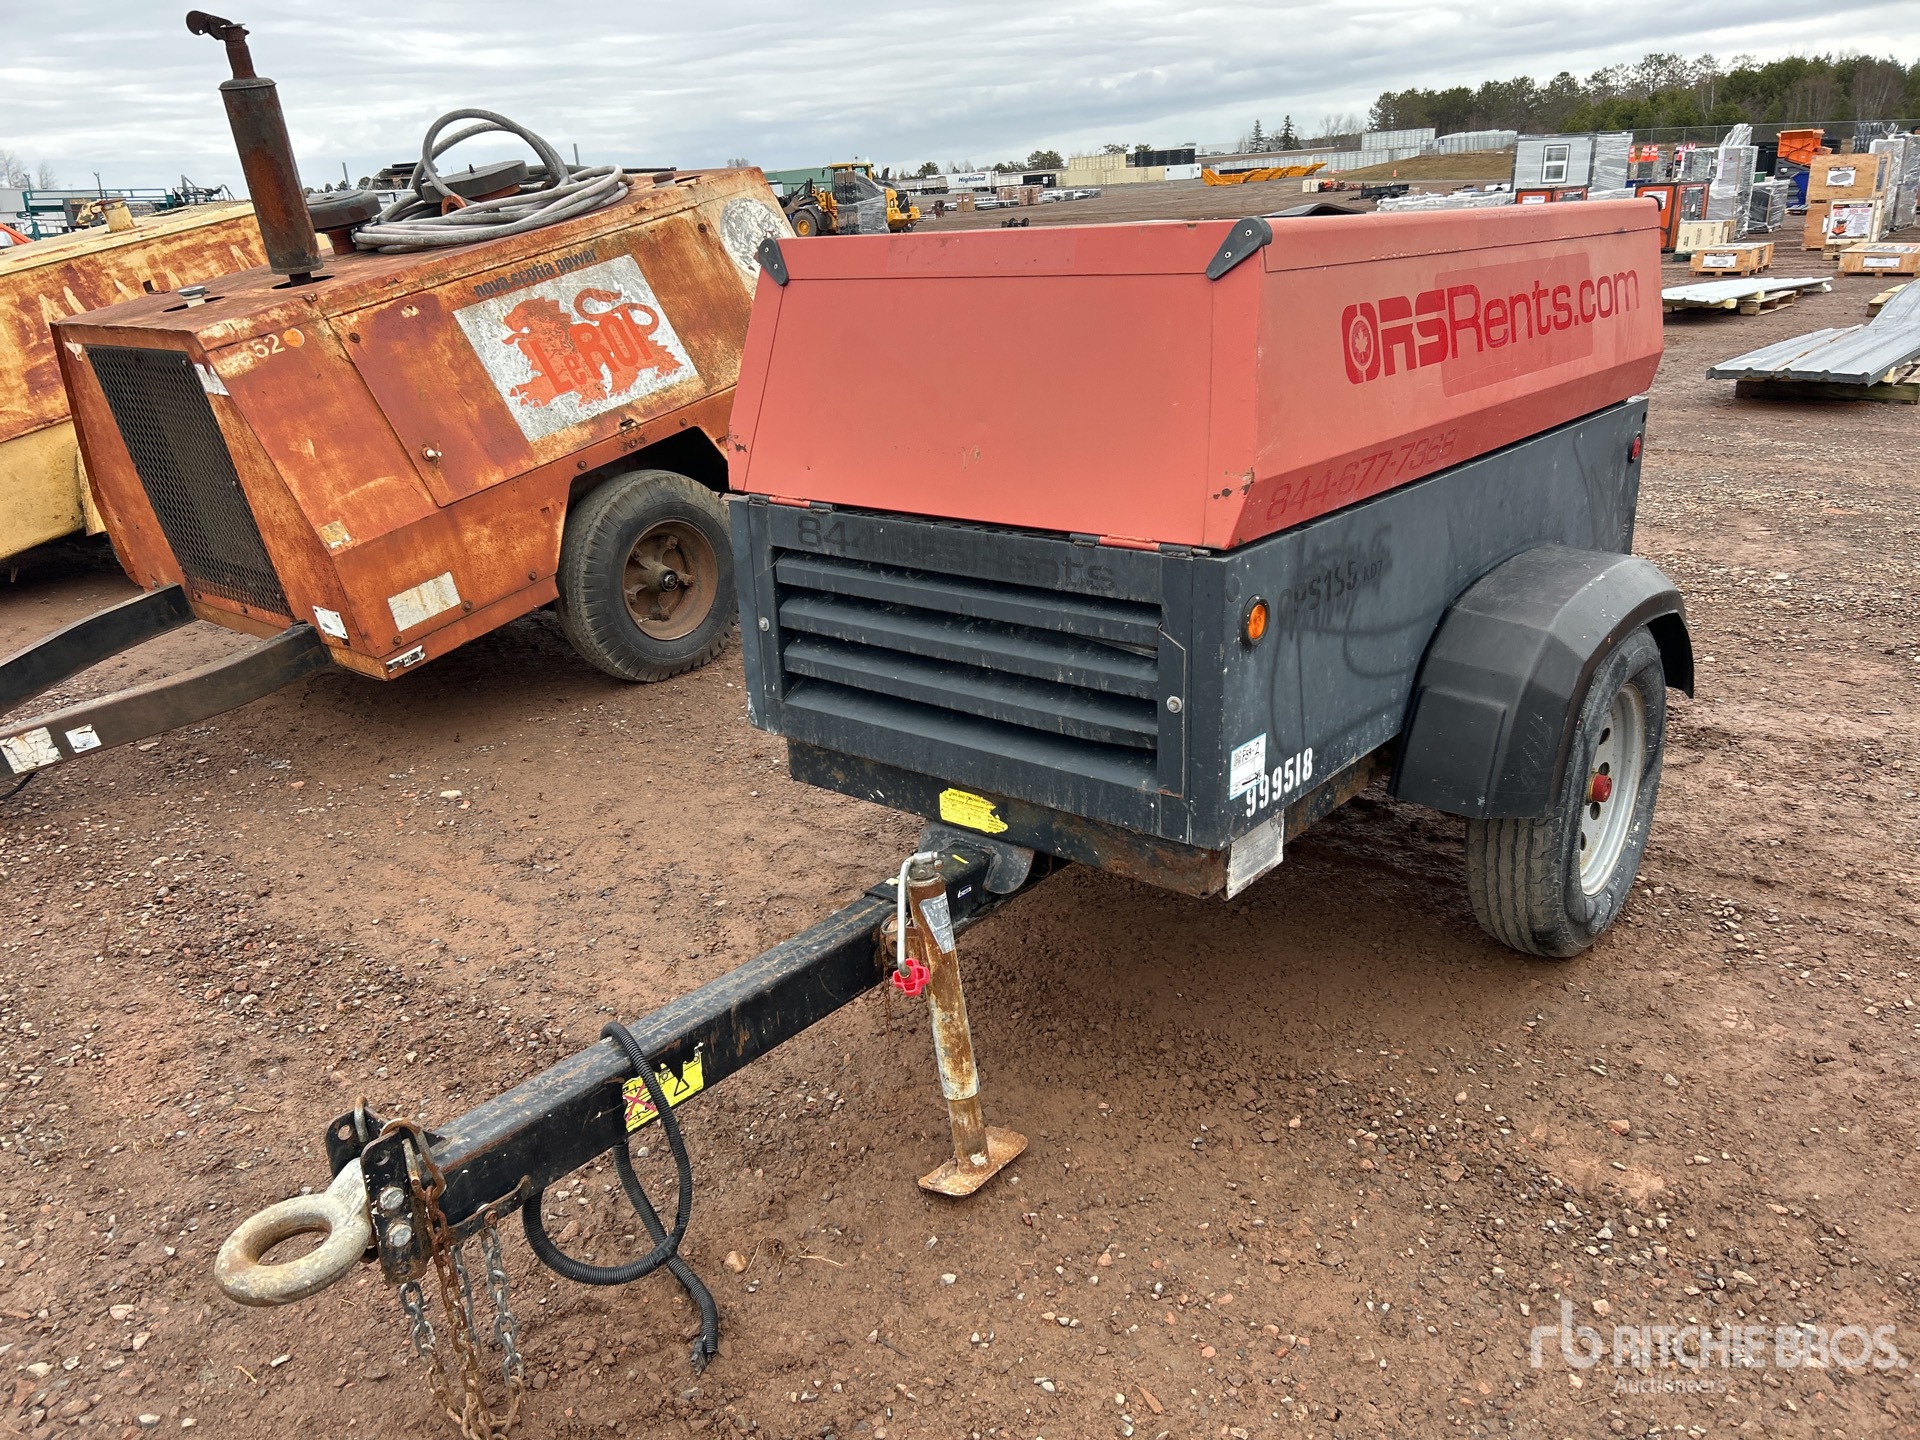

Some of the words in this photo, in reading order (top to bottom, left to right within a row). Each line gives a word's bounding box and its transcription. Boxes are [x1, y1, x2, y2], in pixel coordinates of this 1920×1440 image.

[958, 175, 986, 183] Highland
[473, 275, 511, 299] nova
[510, 259, 555, 286] scotia
[556, 249, 598, 275] power
[1246, 747, 1314, 818] 999518
